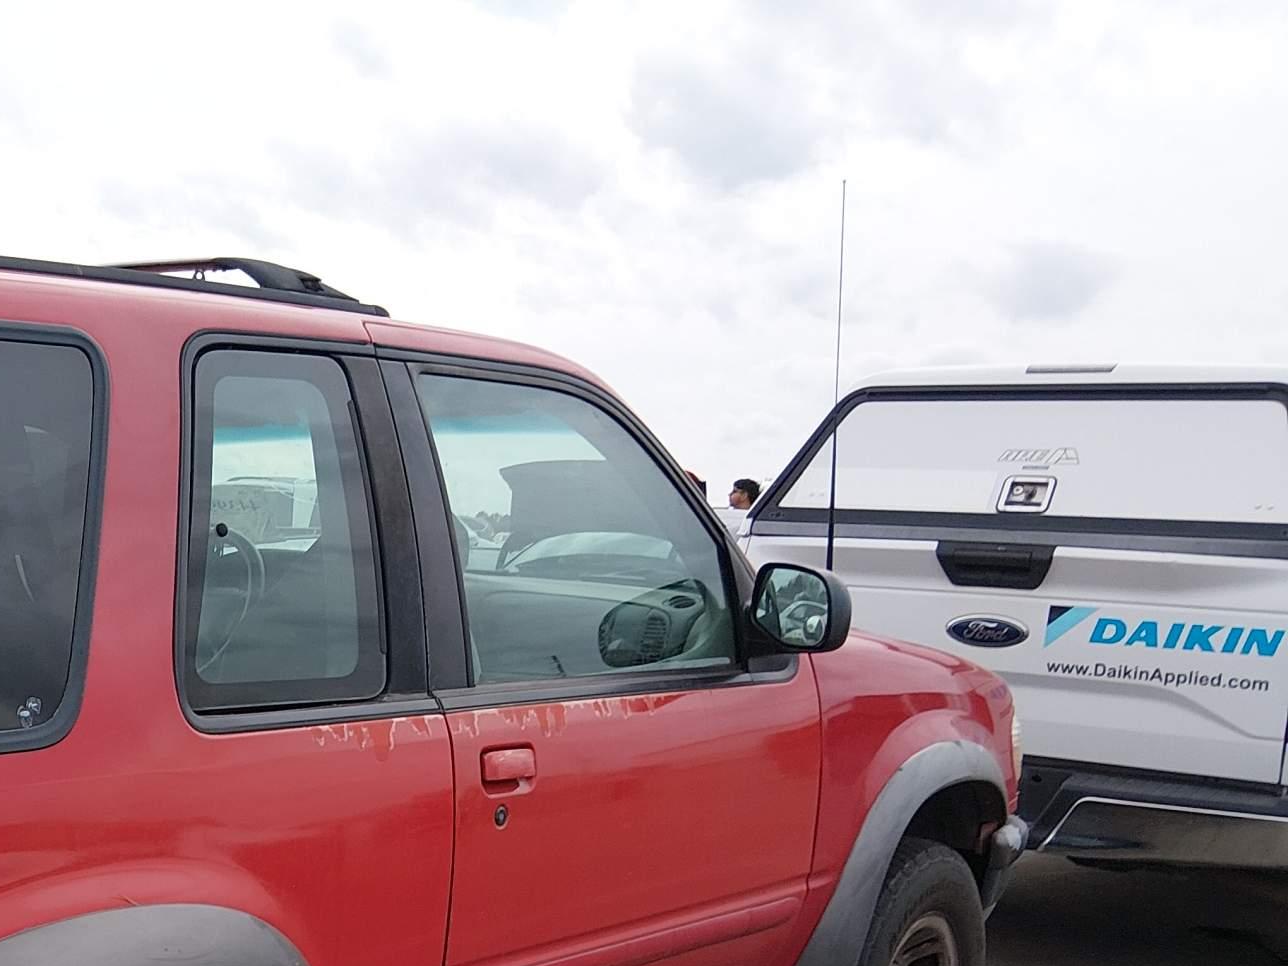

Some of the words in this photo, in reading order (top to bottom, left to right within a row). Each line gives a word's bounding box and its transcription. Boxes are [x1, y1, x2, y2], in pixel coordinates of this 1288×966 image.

[962, 618, 1009, 641] Ford
[1088, 617, 1287, 657] DAIKIN
[1046, 660, 1270, 692] www.DaikinApplied.com
